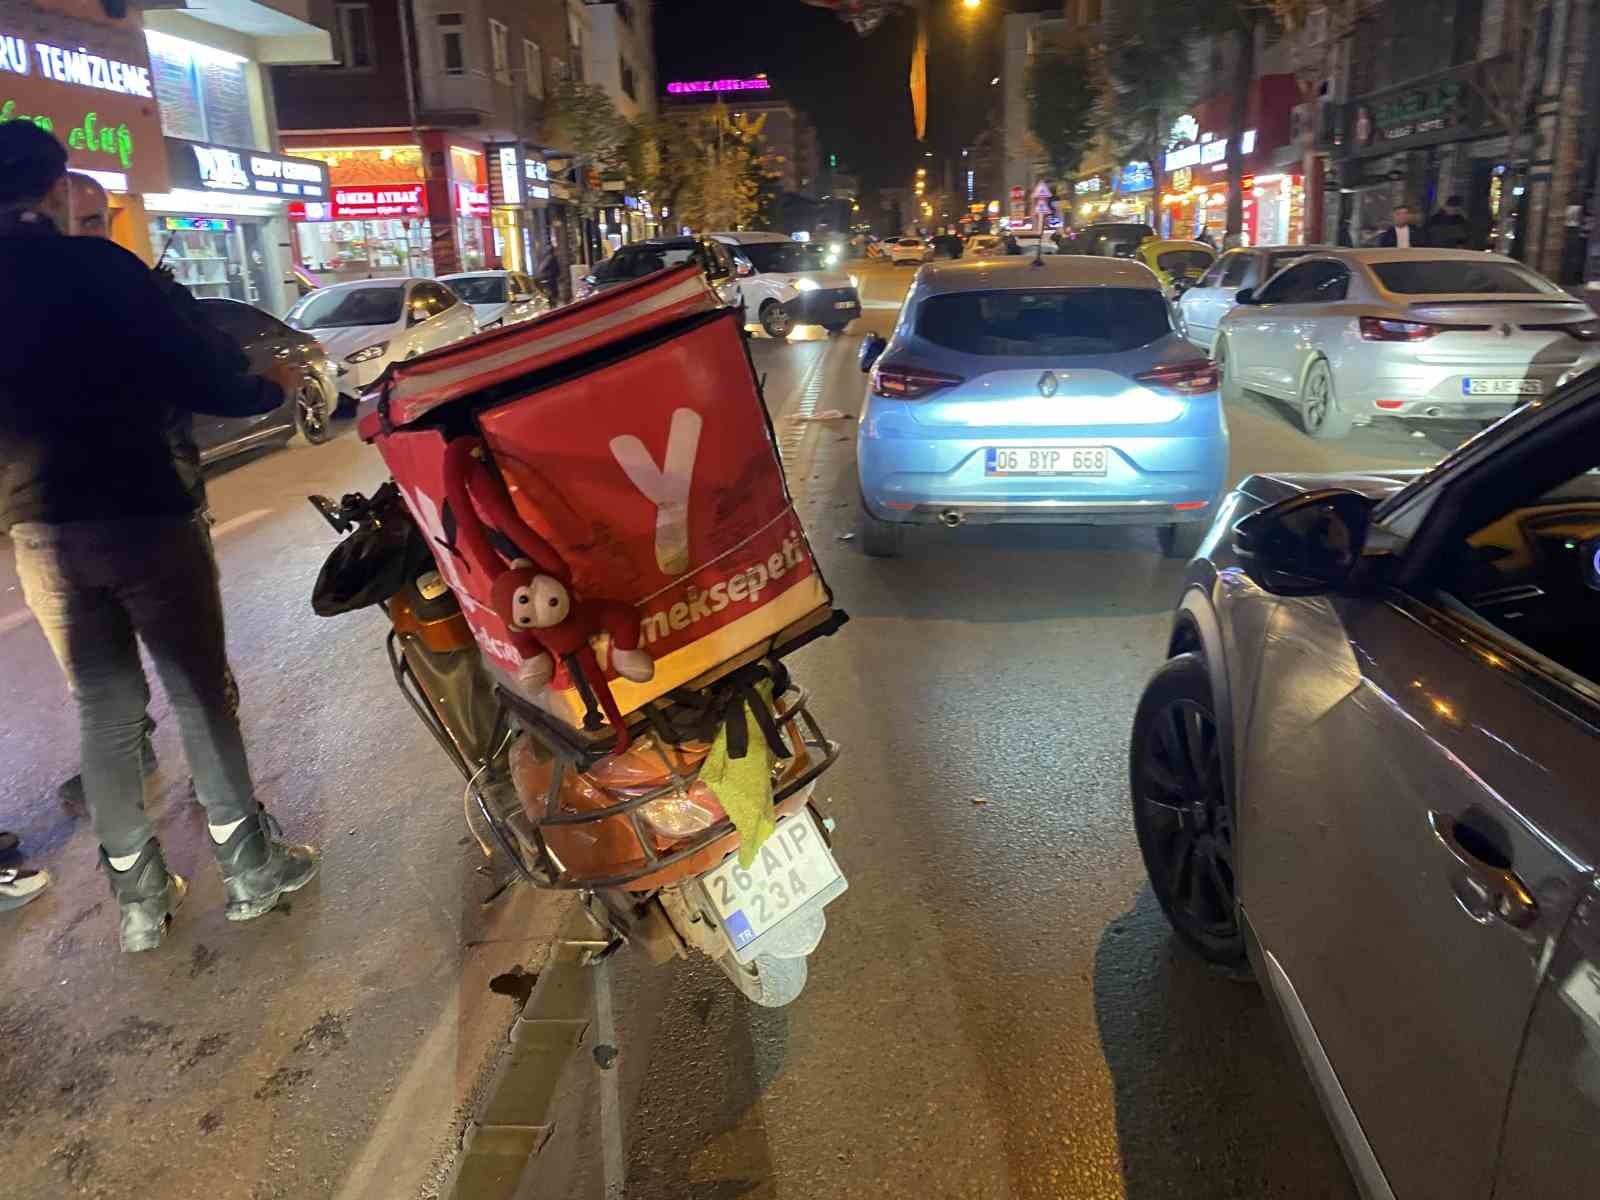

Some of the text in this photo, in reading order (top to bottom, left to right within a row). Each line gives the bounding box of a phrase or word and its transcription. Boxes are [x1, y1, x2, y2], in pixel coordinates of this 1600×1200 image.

[35, 43, 153, 98] TEMİZLEME
[998, 451, 1018, 469] 06
[1029, 451, 1061, 469] BYP
[609, 407, 703, 576] Y
[638, 528, 805, 650] meksepeti
[713, 822, 807, 906] 26 AIP
[751, 868, 807, 923] 234
[737, 927, 756, 943] TR
